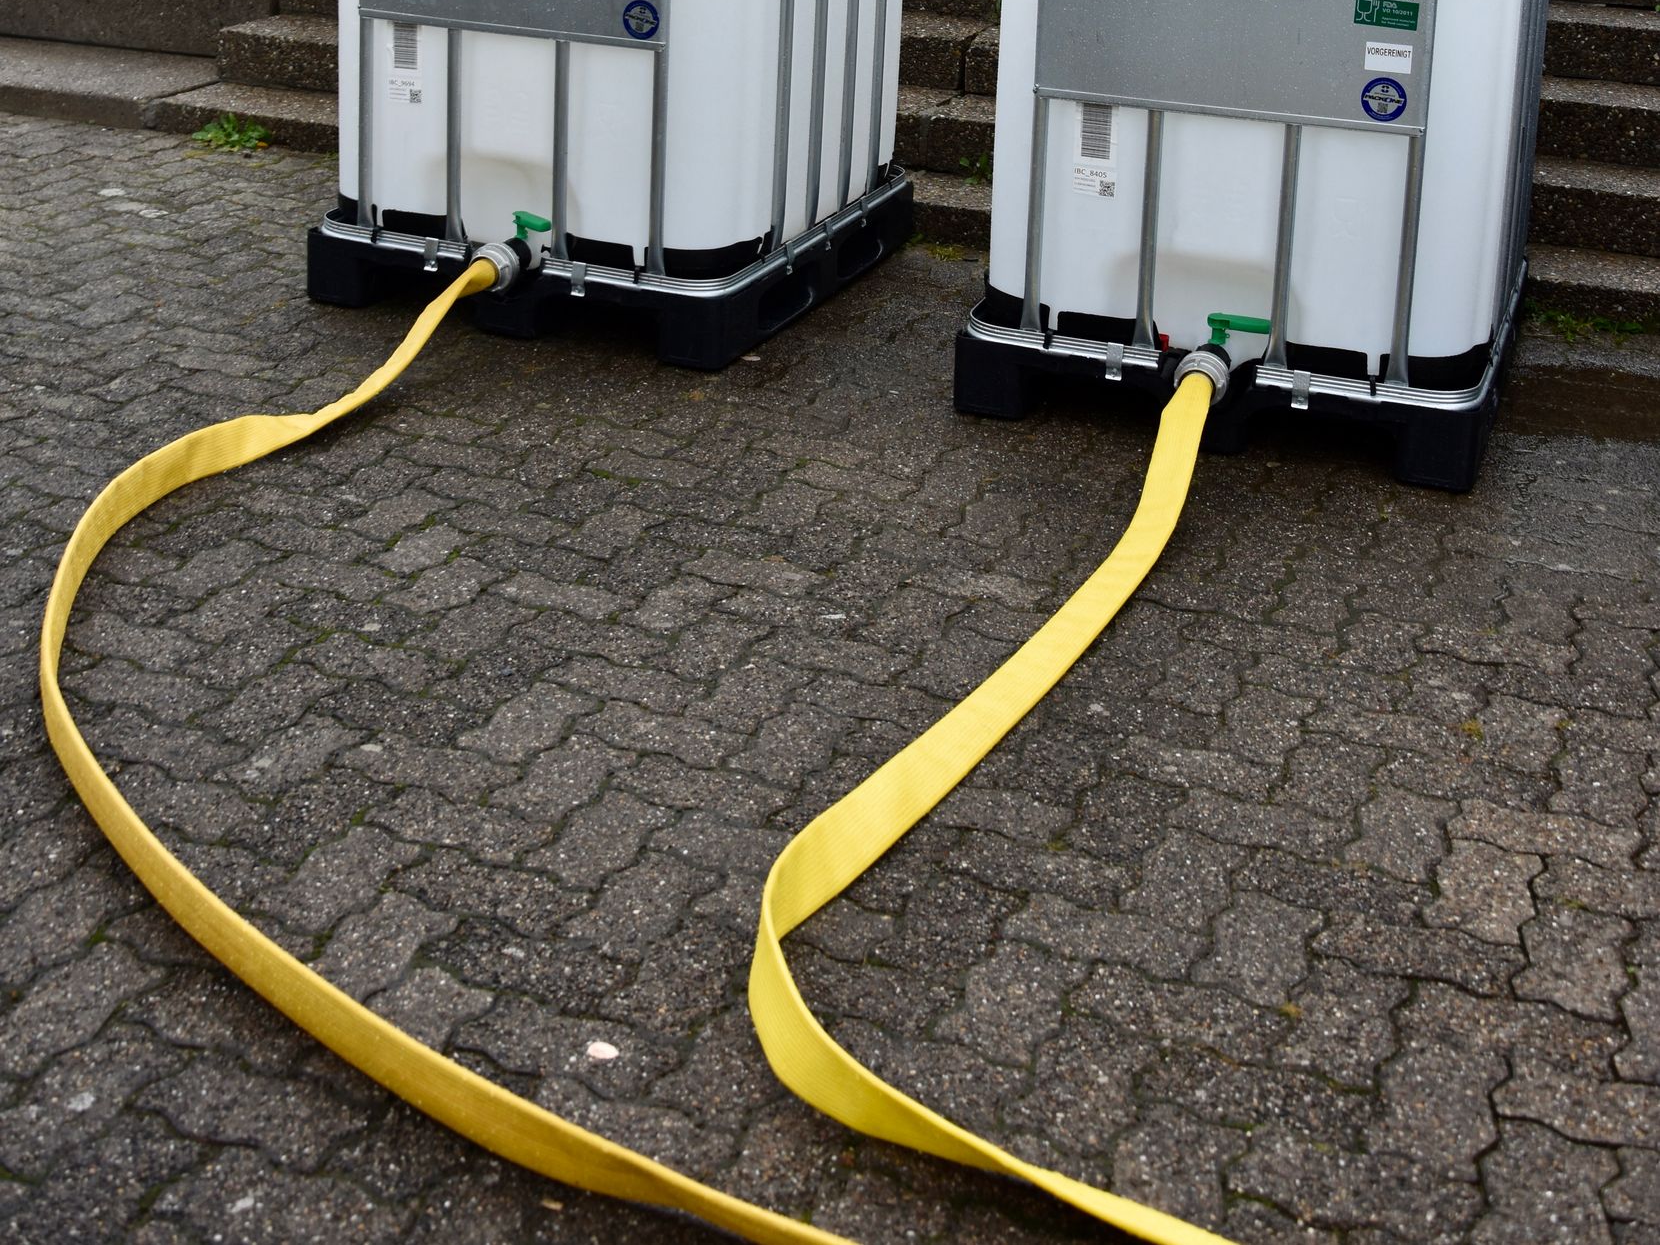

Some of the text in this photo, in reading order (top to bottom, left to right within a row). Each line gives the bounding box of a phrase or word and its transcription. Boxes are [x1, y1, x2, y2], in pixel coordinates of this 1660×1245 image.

[1382, 0, 1398, 9] FDA
[1366, 46, 1412, 59] VORGEREINIGT
[1074, 168, 1108, 178] IBC_8405
